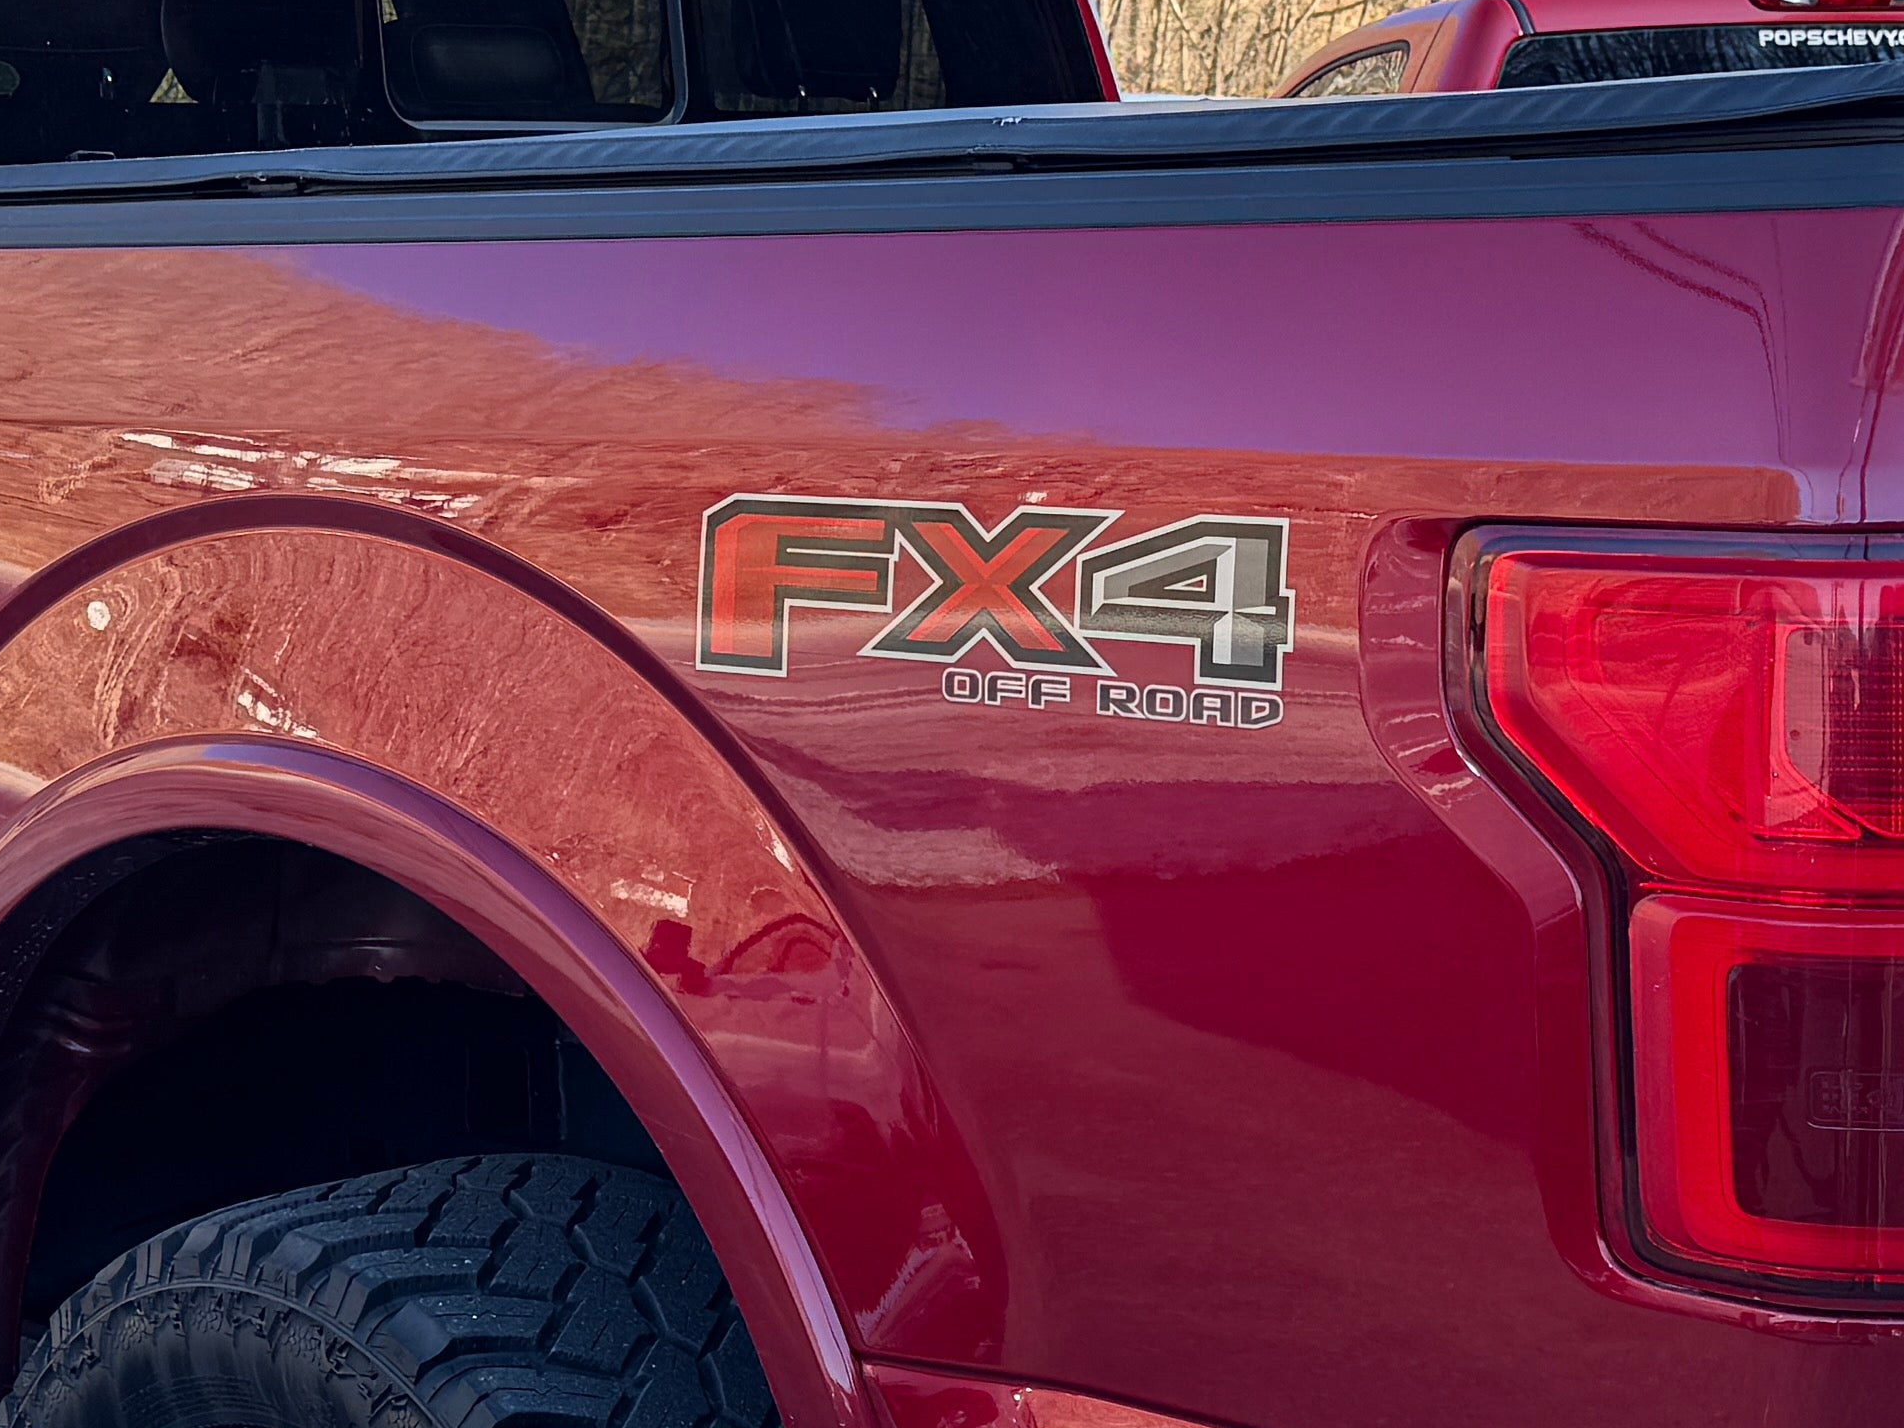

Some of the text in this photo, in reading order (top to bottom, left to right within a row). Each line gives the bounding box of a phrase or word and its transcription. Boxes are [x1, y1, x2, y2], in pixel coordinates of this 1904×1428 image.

[695, 491, 1296, 691] FX4
[941, 666, 1284, 730] OFF ROAD
